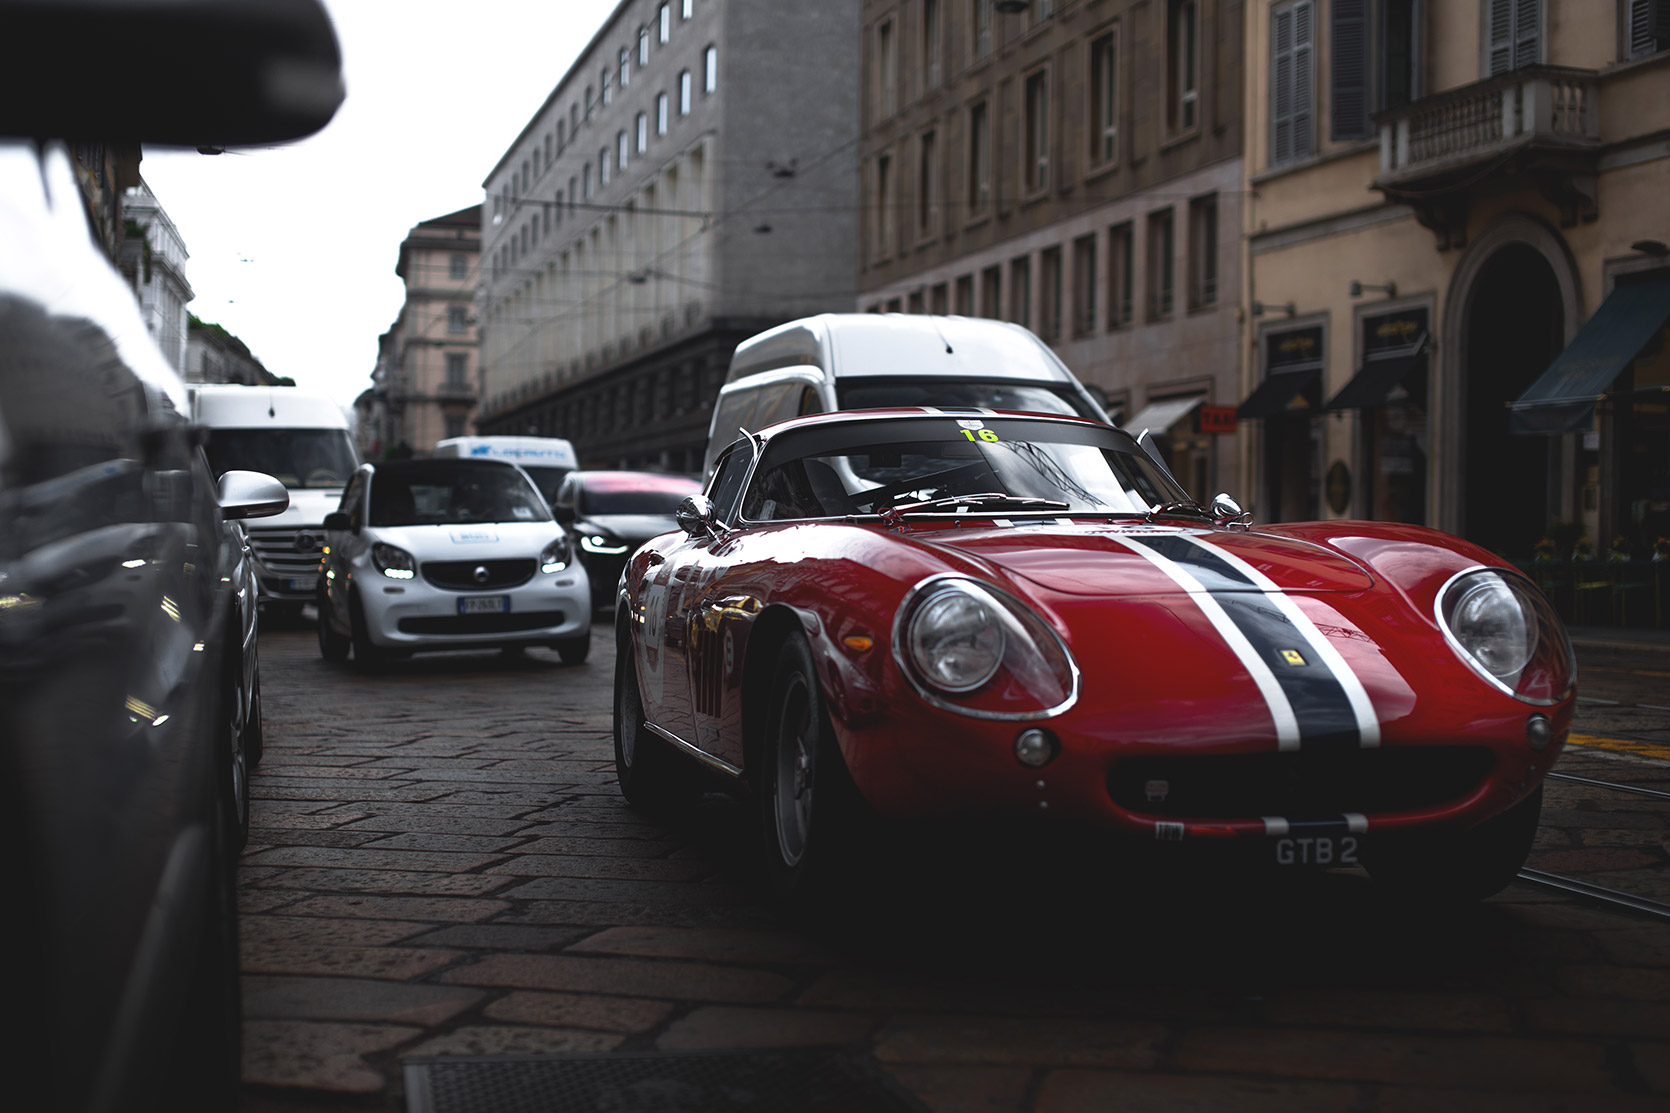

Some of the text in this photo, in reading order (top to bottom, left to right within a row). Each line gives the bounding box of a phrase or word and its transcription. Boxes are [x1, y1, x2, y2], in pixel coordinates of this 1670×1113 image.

[959, 428, 999, 443] 16
[1276, 837, 1358, 864] GTB 2
